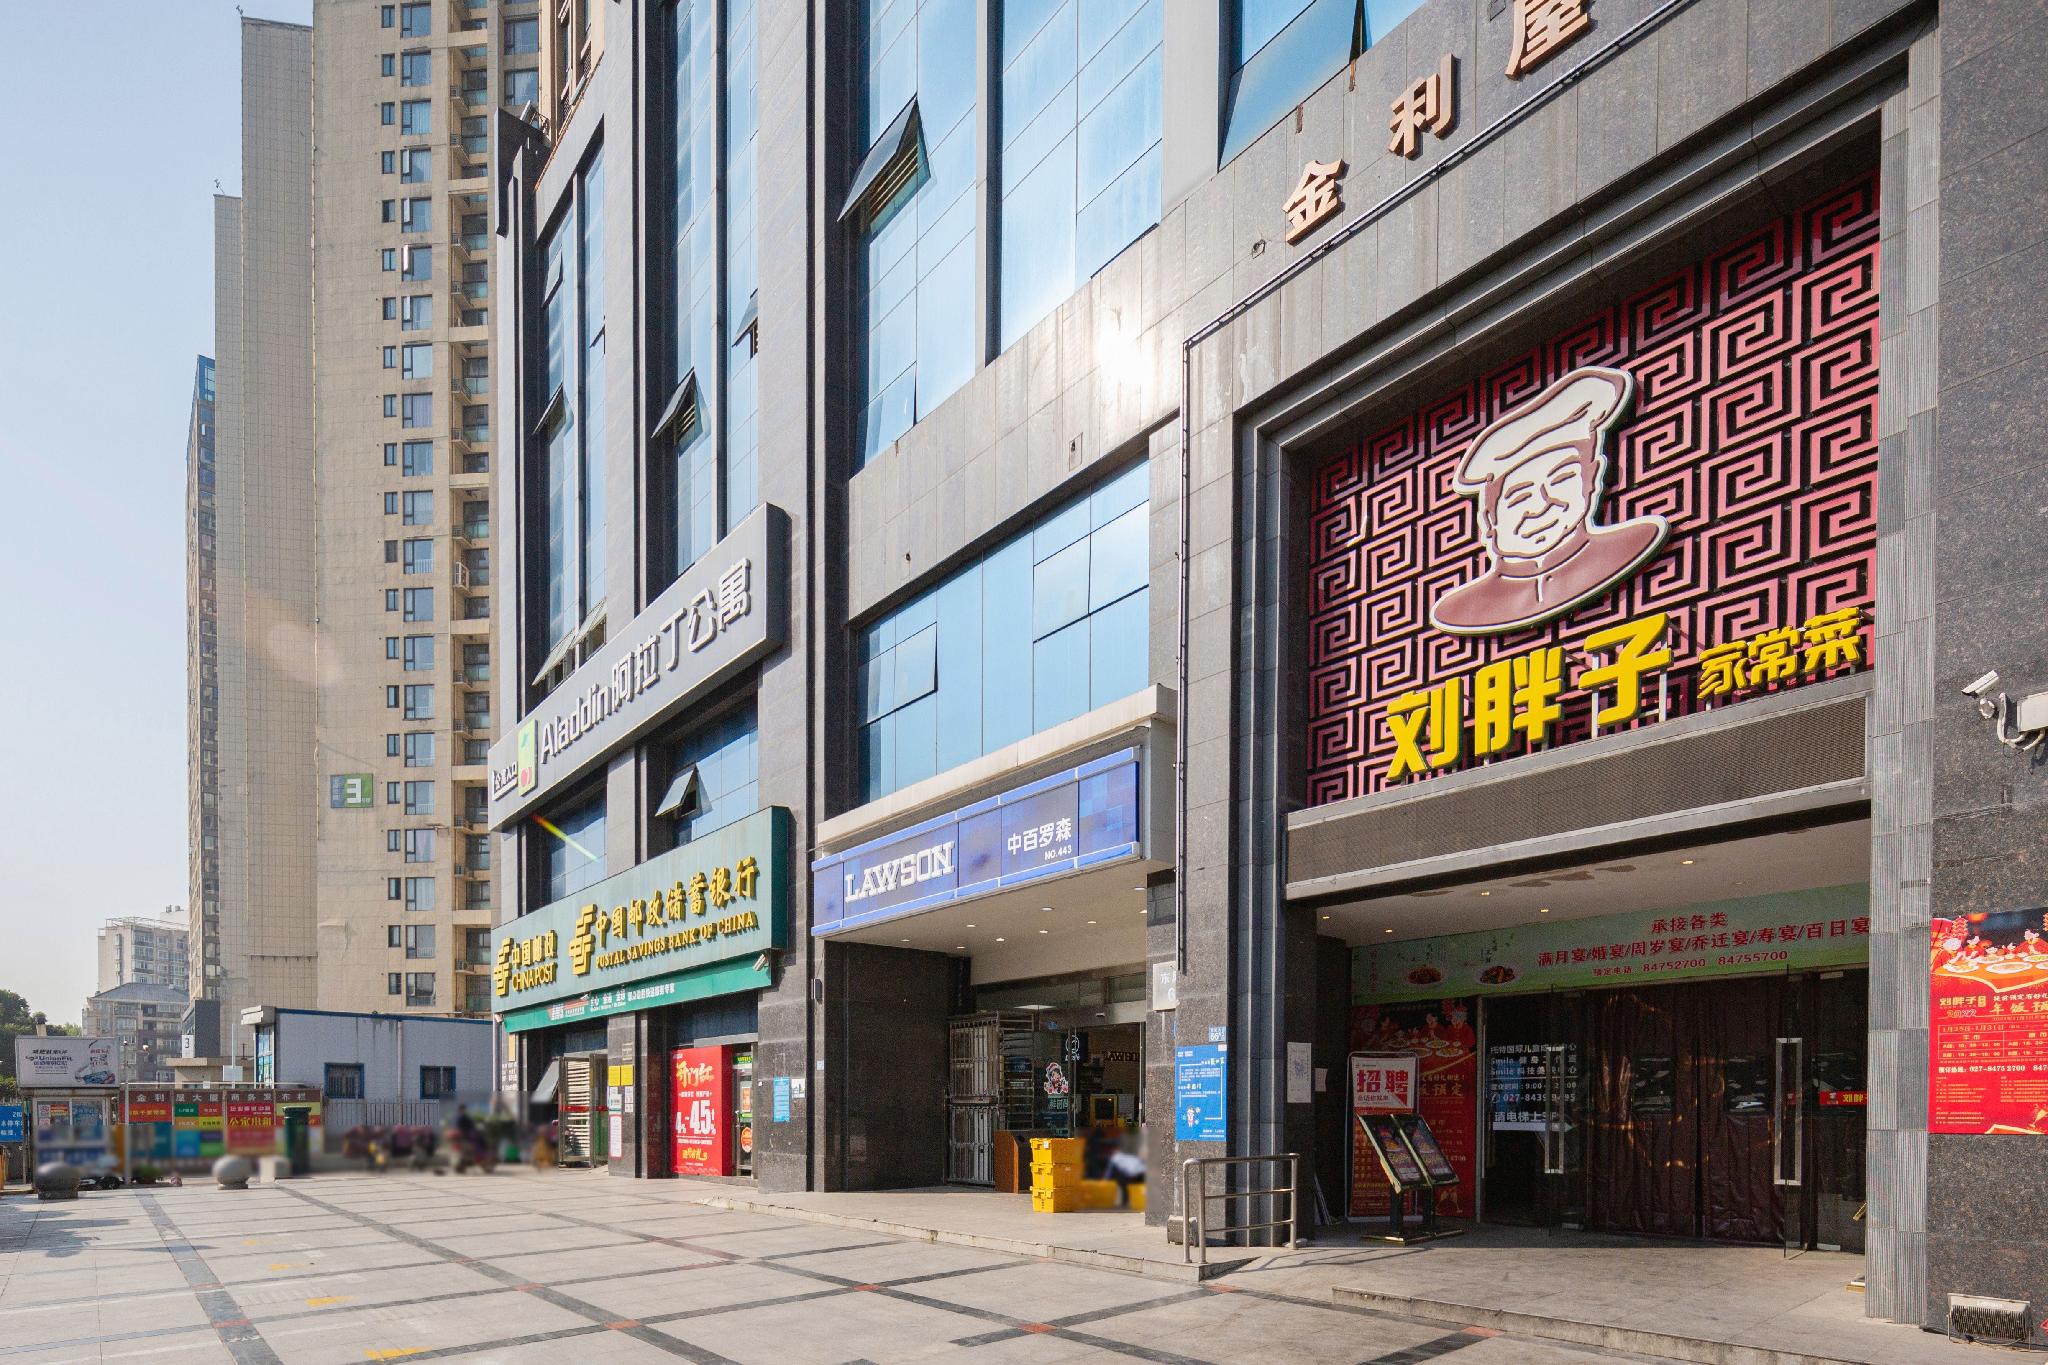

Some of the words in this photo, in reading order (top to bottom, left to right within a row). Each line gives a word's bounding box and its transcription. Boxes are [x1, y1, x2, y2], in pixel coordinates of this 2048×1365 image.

[540, 683, 613, 764] Aladdin
[613, 557, 751, 711] 阿拉丁公寓
[1385, 612, 1675, 782] 刘胖子
[1698, 607, 1863, 699] 家常菜
[1007, 817, 1072, 855] 中百罗森
[845, 841, 956, 903] LAWSON
[596, 856, 758, 948] 中国邮政储蓄银行
[595, 948, 625, 969] POSTAL
[627, 940, 667, 964] SAVINGS
[669, 928, 699, 949] BANK
[700, 923, 715, 940] OF
[717, 911, 759, 935] CHINA
[1651, 911, 1728, 934] 承接各类
[512, 929, 558, 970] 中国邮政
[1643, 958, 1706, 973] 84752700
[1718, 950, 1788, 966] 84755700
[512, 970, 535, 992] CHINA
[535, 964, 557, 987] POST
[184, 1037, 190, 1049] 3
[1357, 1070, 1409, 1093] 招聘
[1842, 1093, 1866, 1103] 刘胖
